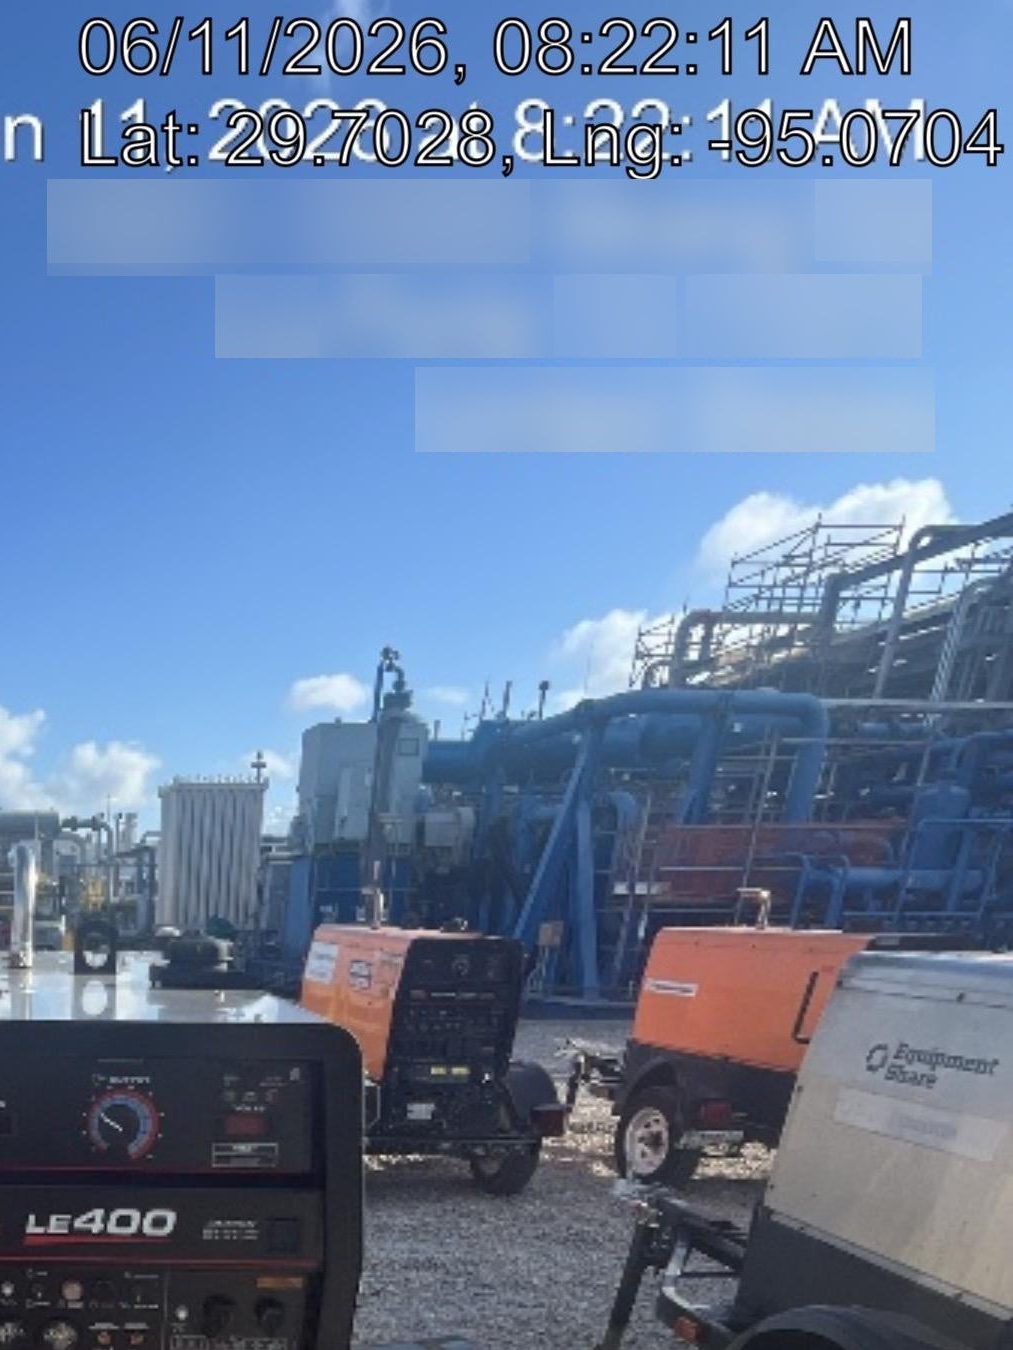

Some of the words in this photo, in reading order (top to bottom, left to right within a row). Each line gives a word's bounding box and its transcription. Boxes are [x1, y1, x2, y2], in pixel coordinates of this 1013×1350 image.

[892, 1042, 1001, 1076] Equipment
[884, 1063, 939, 1089] Share
[25, 1208, 178, 1237] LE400
